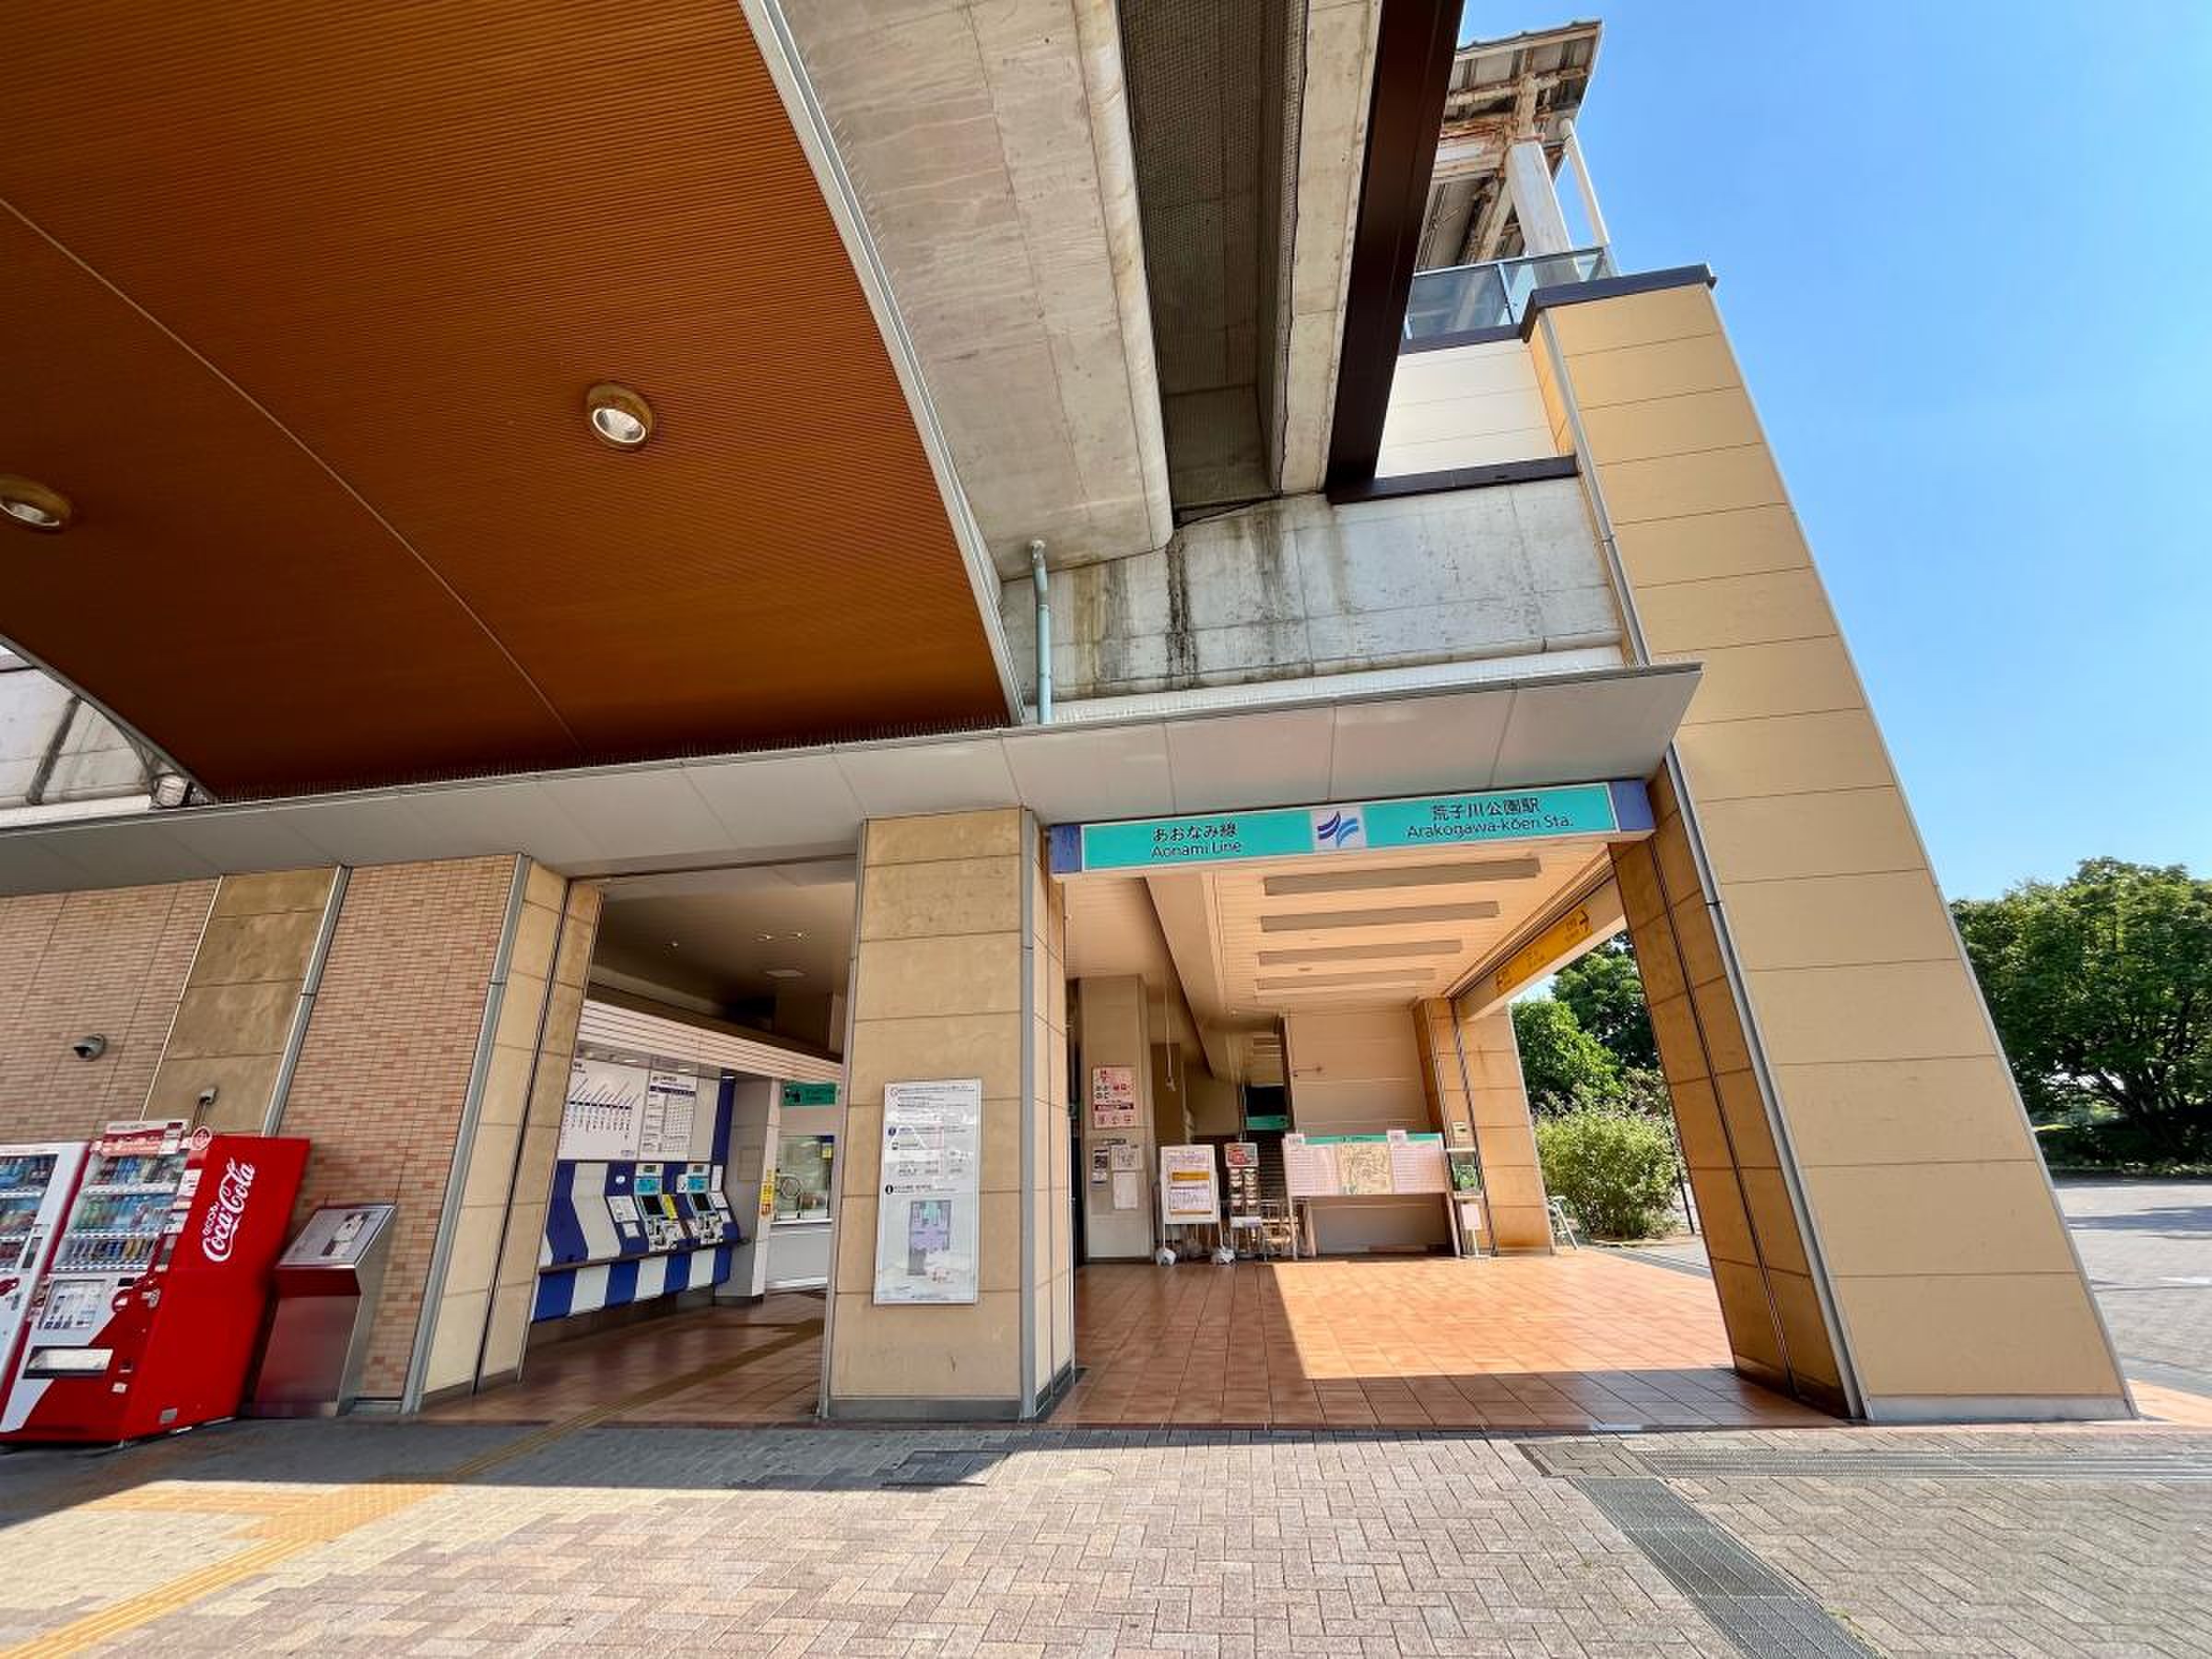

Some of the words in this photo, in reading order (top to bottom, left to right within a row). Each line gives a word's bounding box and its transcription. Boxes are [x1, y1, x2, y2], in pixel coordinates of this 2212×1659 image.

[1432, 797, 1540, 819] 荒子川公園駅
[1545, 814, 1573, 829] Sta.
[1153, 822, 1236, 841] あおなみ線
[1151, 843, 1208, 858] Aonami
[1212, 841, 1241, 854] Line
